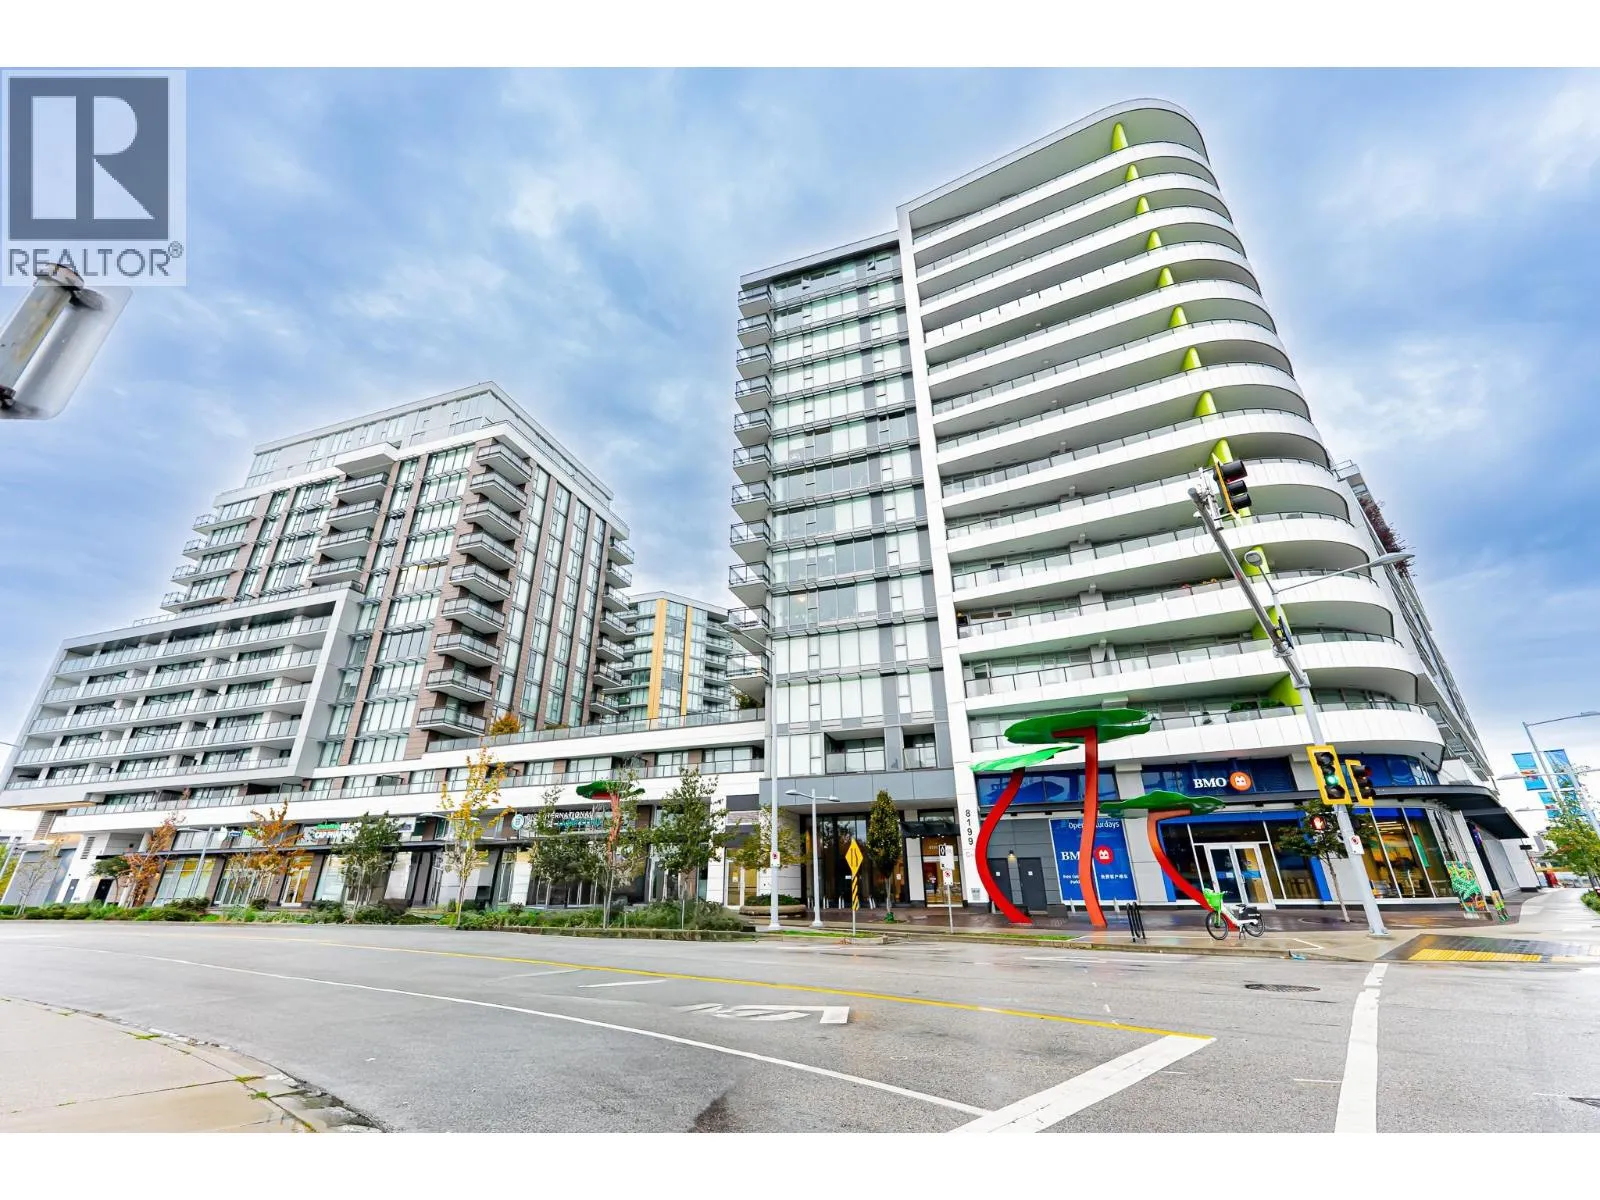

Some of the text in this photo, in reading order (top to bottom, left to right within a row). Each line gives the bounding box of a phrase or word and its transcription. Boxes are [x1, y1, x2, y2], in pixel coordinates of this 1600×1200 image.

[1193, 777, 1227, 789] BMO
[965, 809, 974, 846] 8199
[1061, 851, 1080, 861] BM
